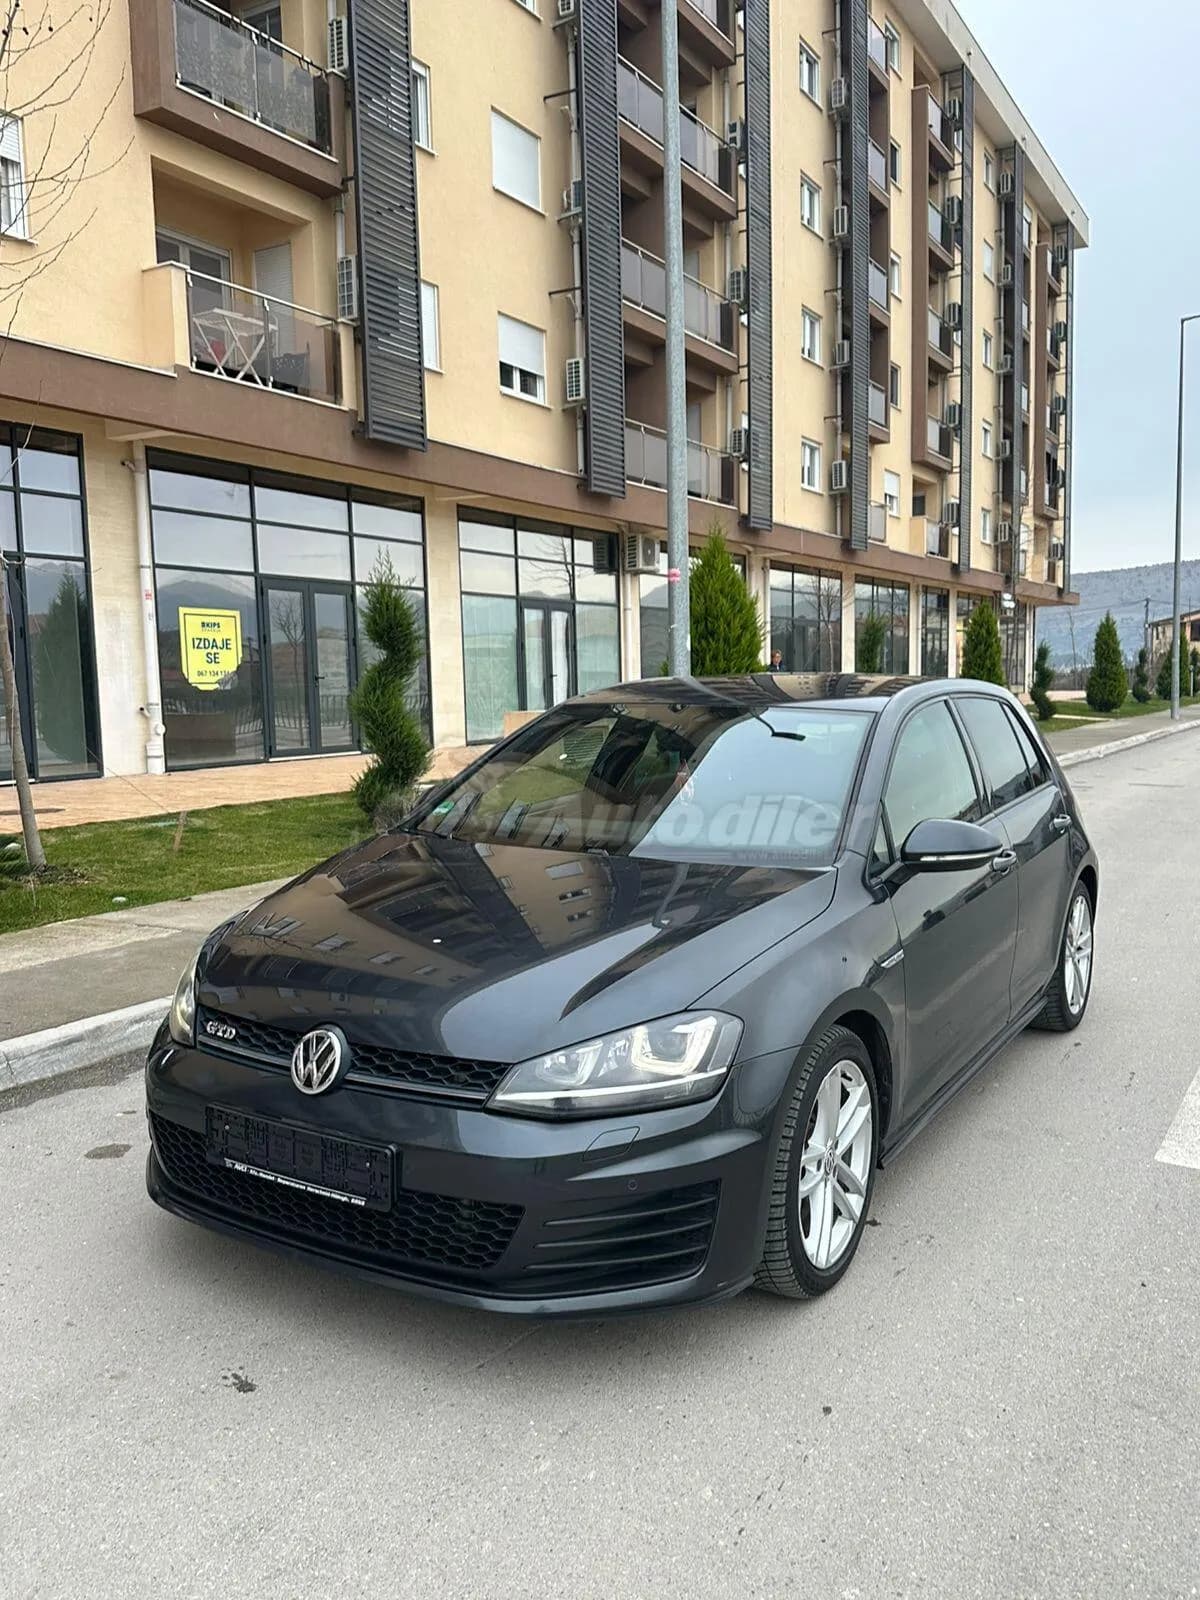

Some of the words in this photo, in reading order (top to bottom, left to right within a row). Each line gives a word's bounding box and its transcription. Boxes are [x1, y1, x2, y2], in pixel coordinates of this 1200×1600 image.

[192, 637, 232, 650] IZDAJE
[206, 652, 220, 664] SE
[206, 1021, 236, 1040] GTD
